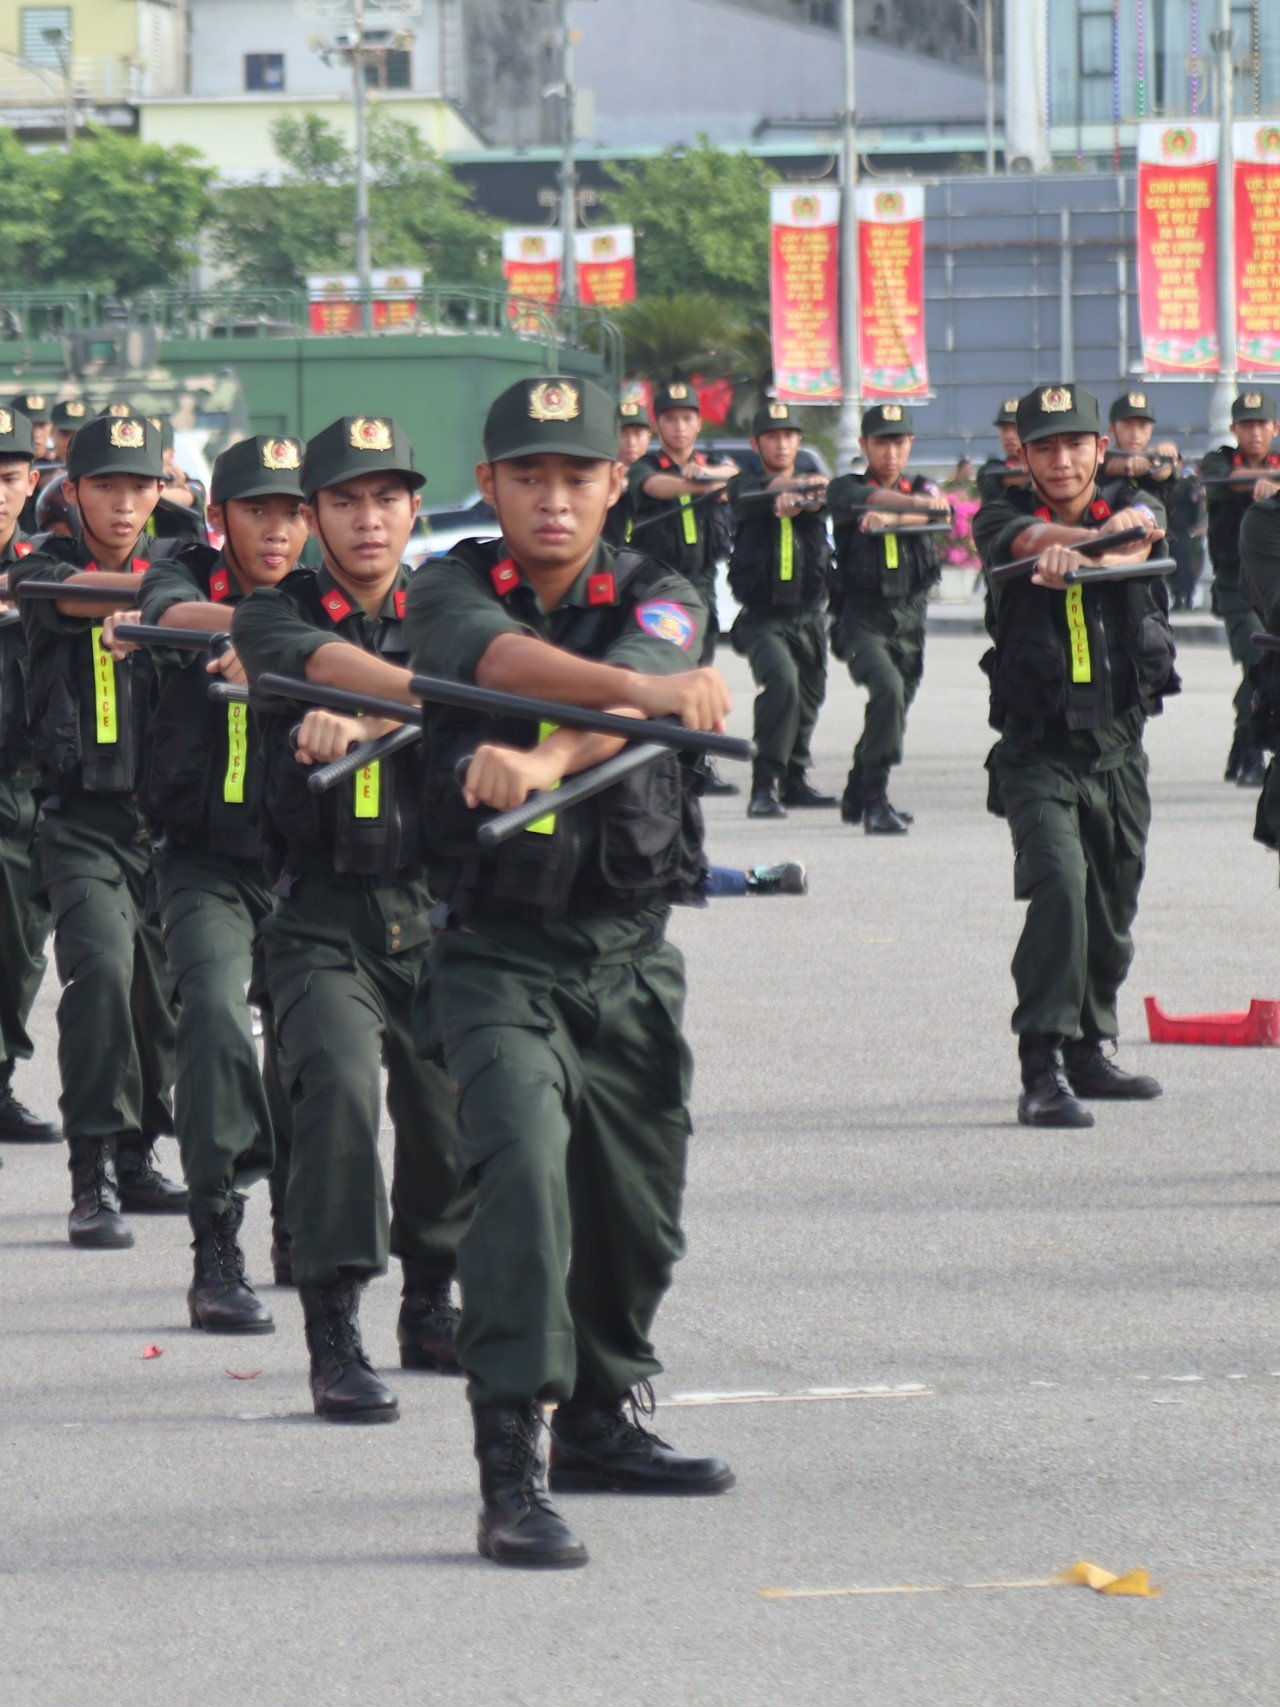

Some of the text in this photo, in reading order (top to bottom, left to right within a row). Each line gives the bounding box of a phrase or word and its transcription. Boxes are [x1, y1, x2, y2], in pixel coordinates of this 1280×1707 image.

[1071, 591, 1085, 667] POLICE
[100, 655, 110, 728] OLICE
[231, 705, 242, 783] OLICE
